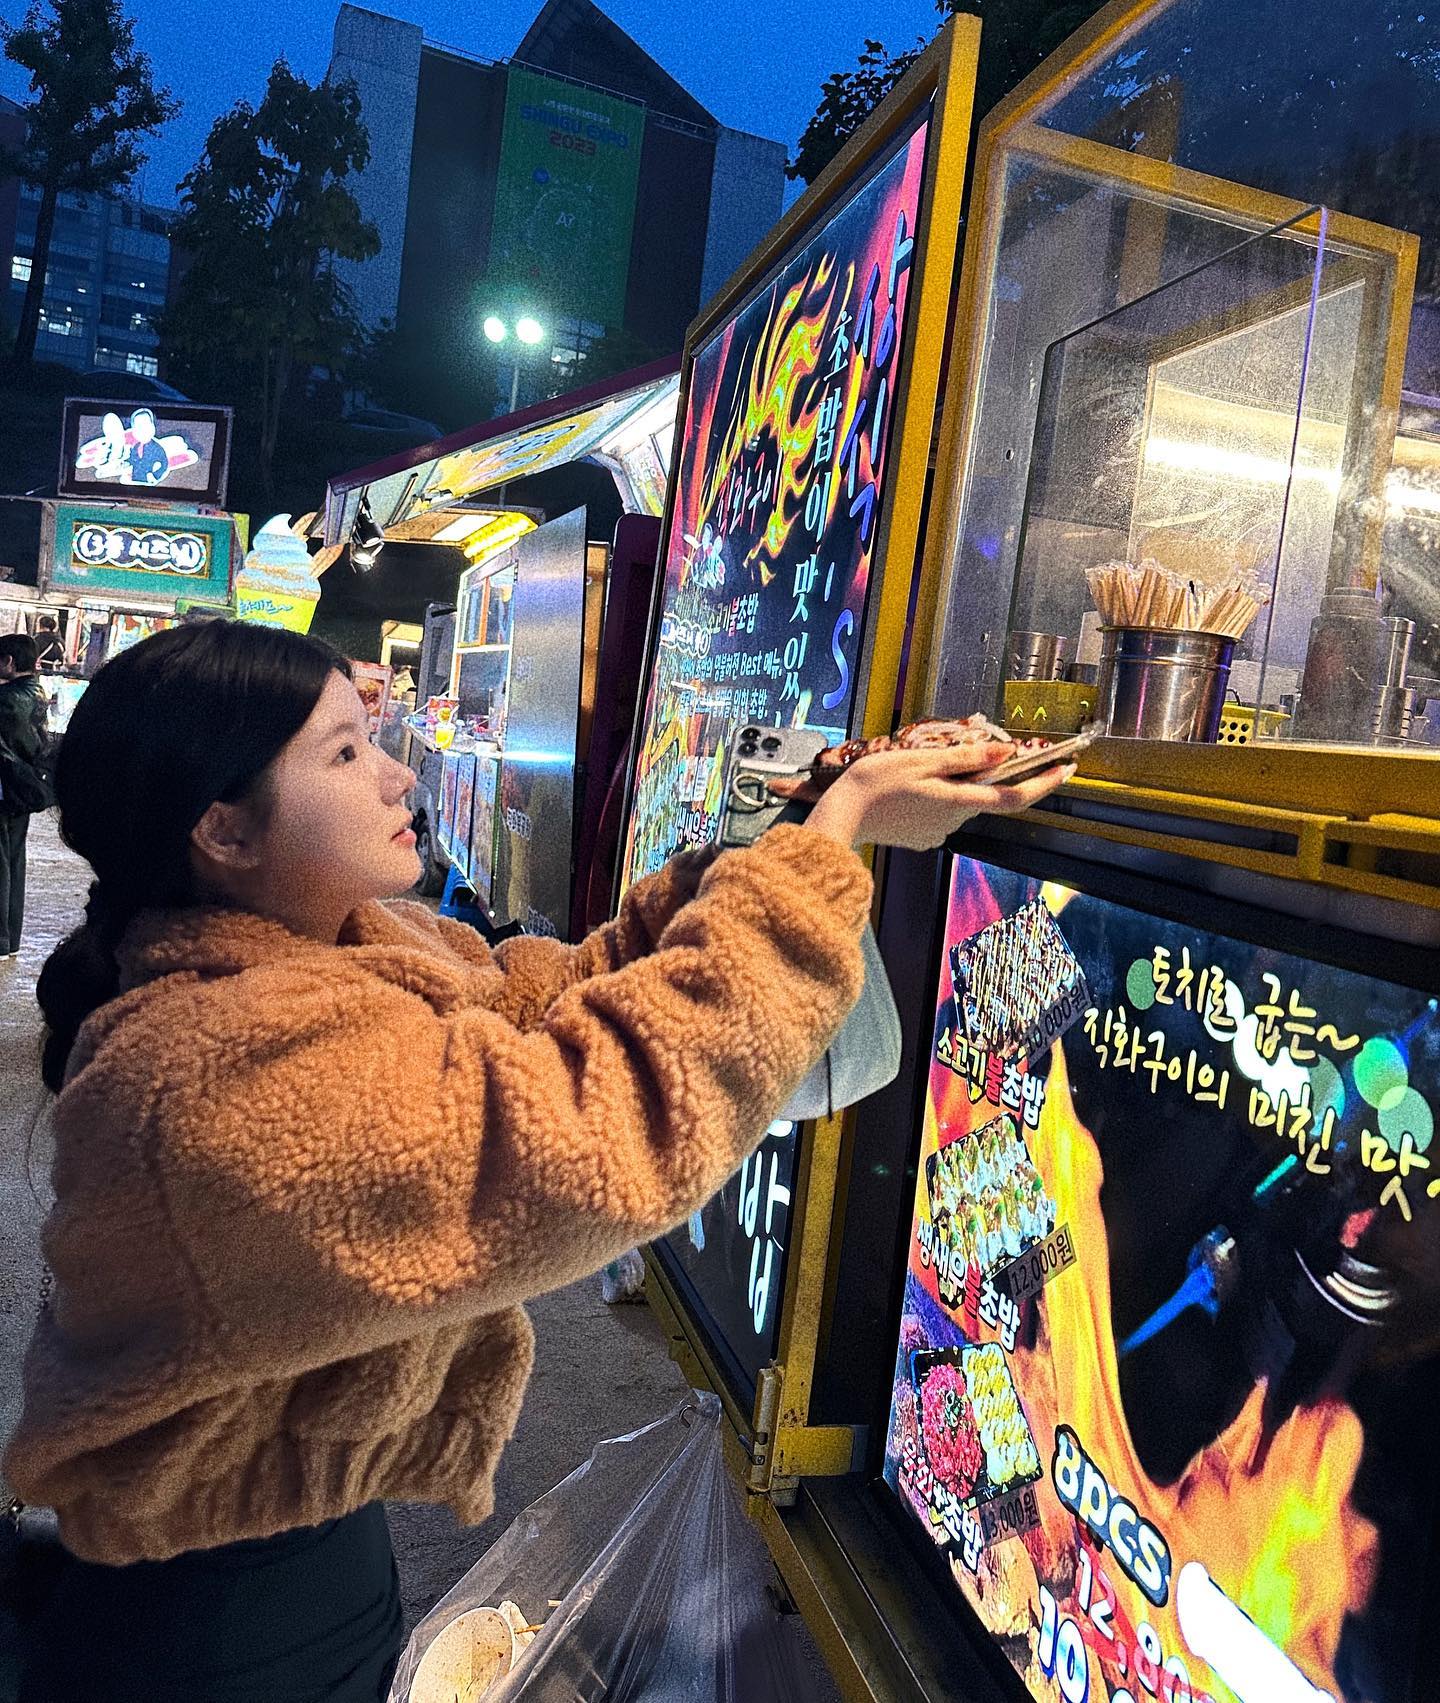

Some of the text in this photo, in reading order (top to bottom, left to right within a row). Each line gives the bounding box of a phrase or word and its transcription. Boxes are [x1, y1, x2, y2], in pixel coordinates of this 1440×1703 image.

[774, 310, 853, 727] 초밥이 맛있
[740, 650, 762, 676] Best
[936, 1027, 1046, 1126] 소고기불초밥
[1084, 1005, 1230, 1109] 직화구이의
[1249, 1083, 1335, 1174] 미친
[917, 1216, 1021, 1352] 생새우불초밥
[1011, 1229, 1073, 1297] 12,000원
